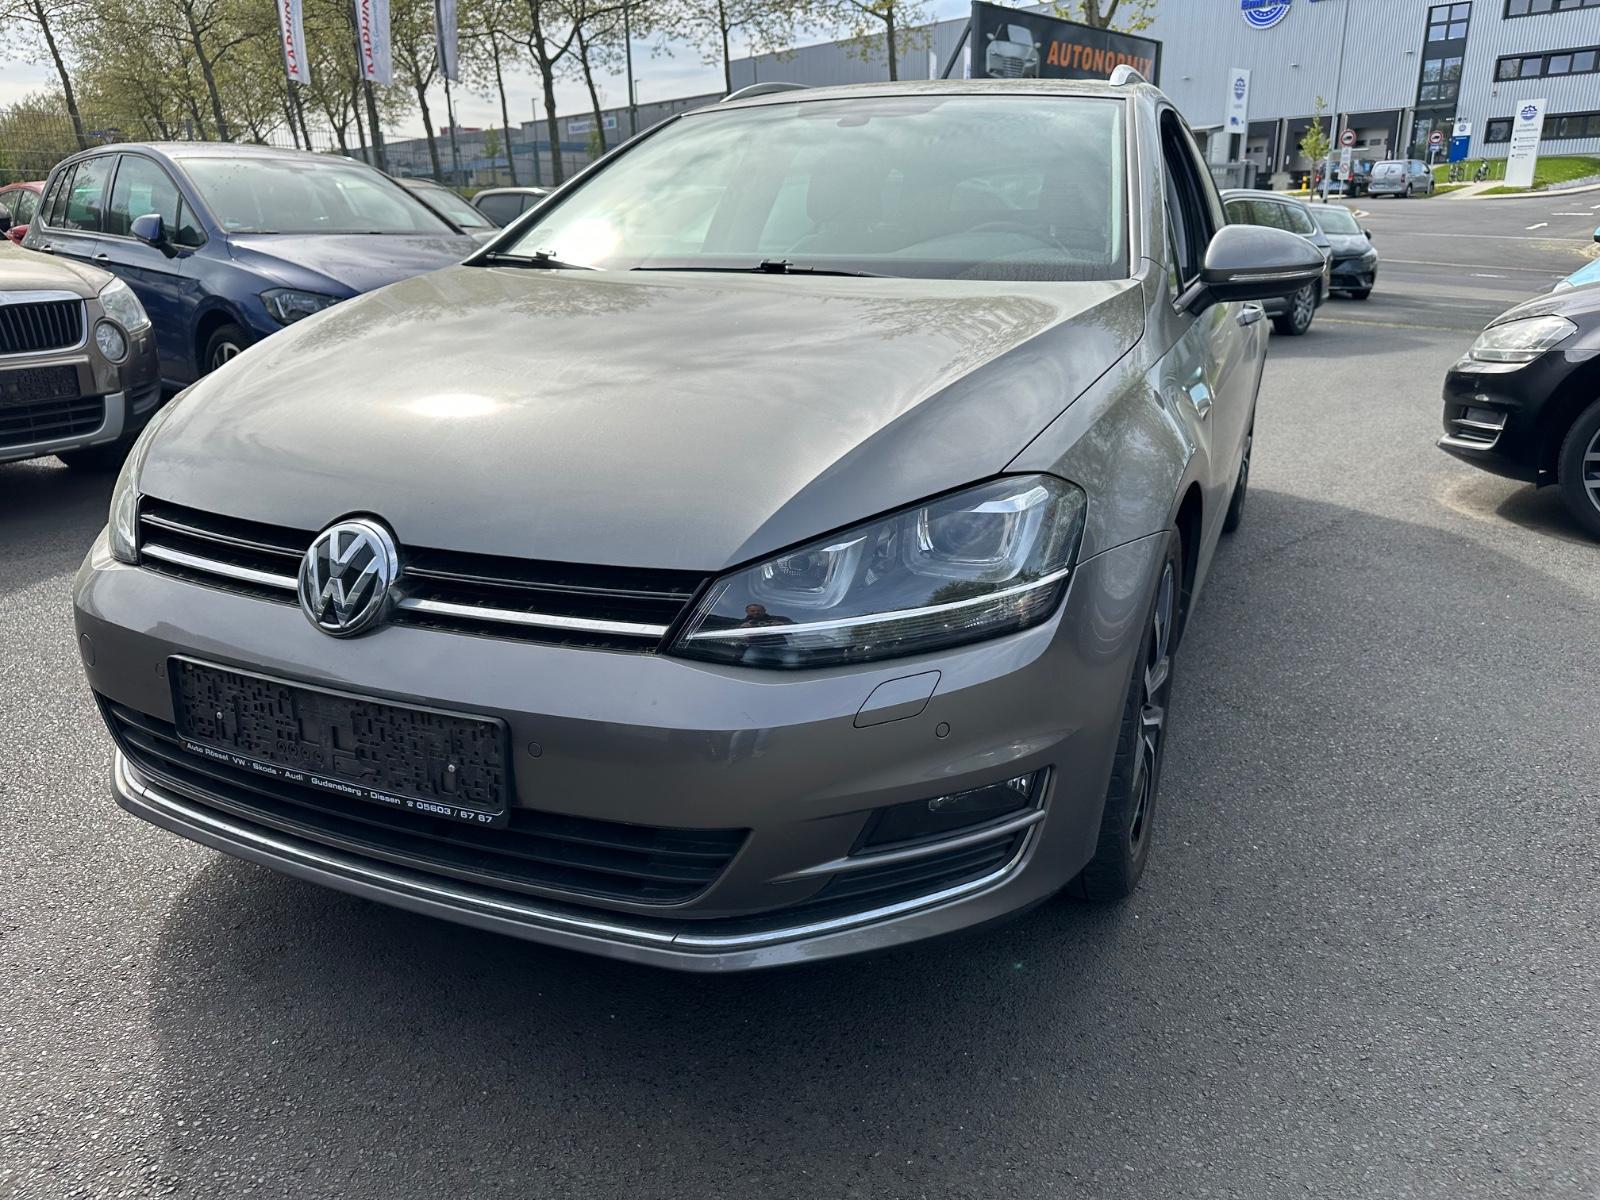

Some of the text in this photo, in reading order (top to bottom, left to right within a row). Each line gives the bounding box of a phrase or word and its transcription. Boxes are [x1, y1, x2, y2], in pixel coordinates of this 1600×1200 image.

[187, 742, 204, 753] Auto
[232, 756, 246, 766] VW
[253, 763, 277, 775] Skoda
[285, 771, 304, 781] Audi
[311, 777, 362, 796] Gudensberg
[370, 791, 401, 804] Dissen
